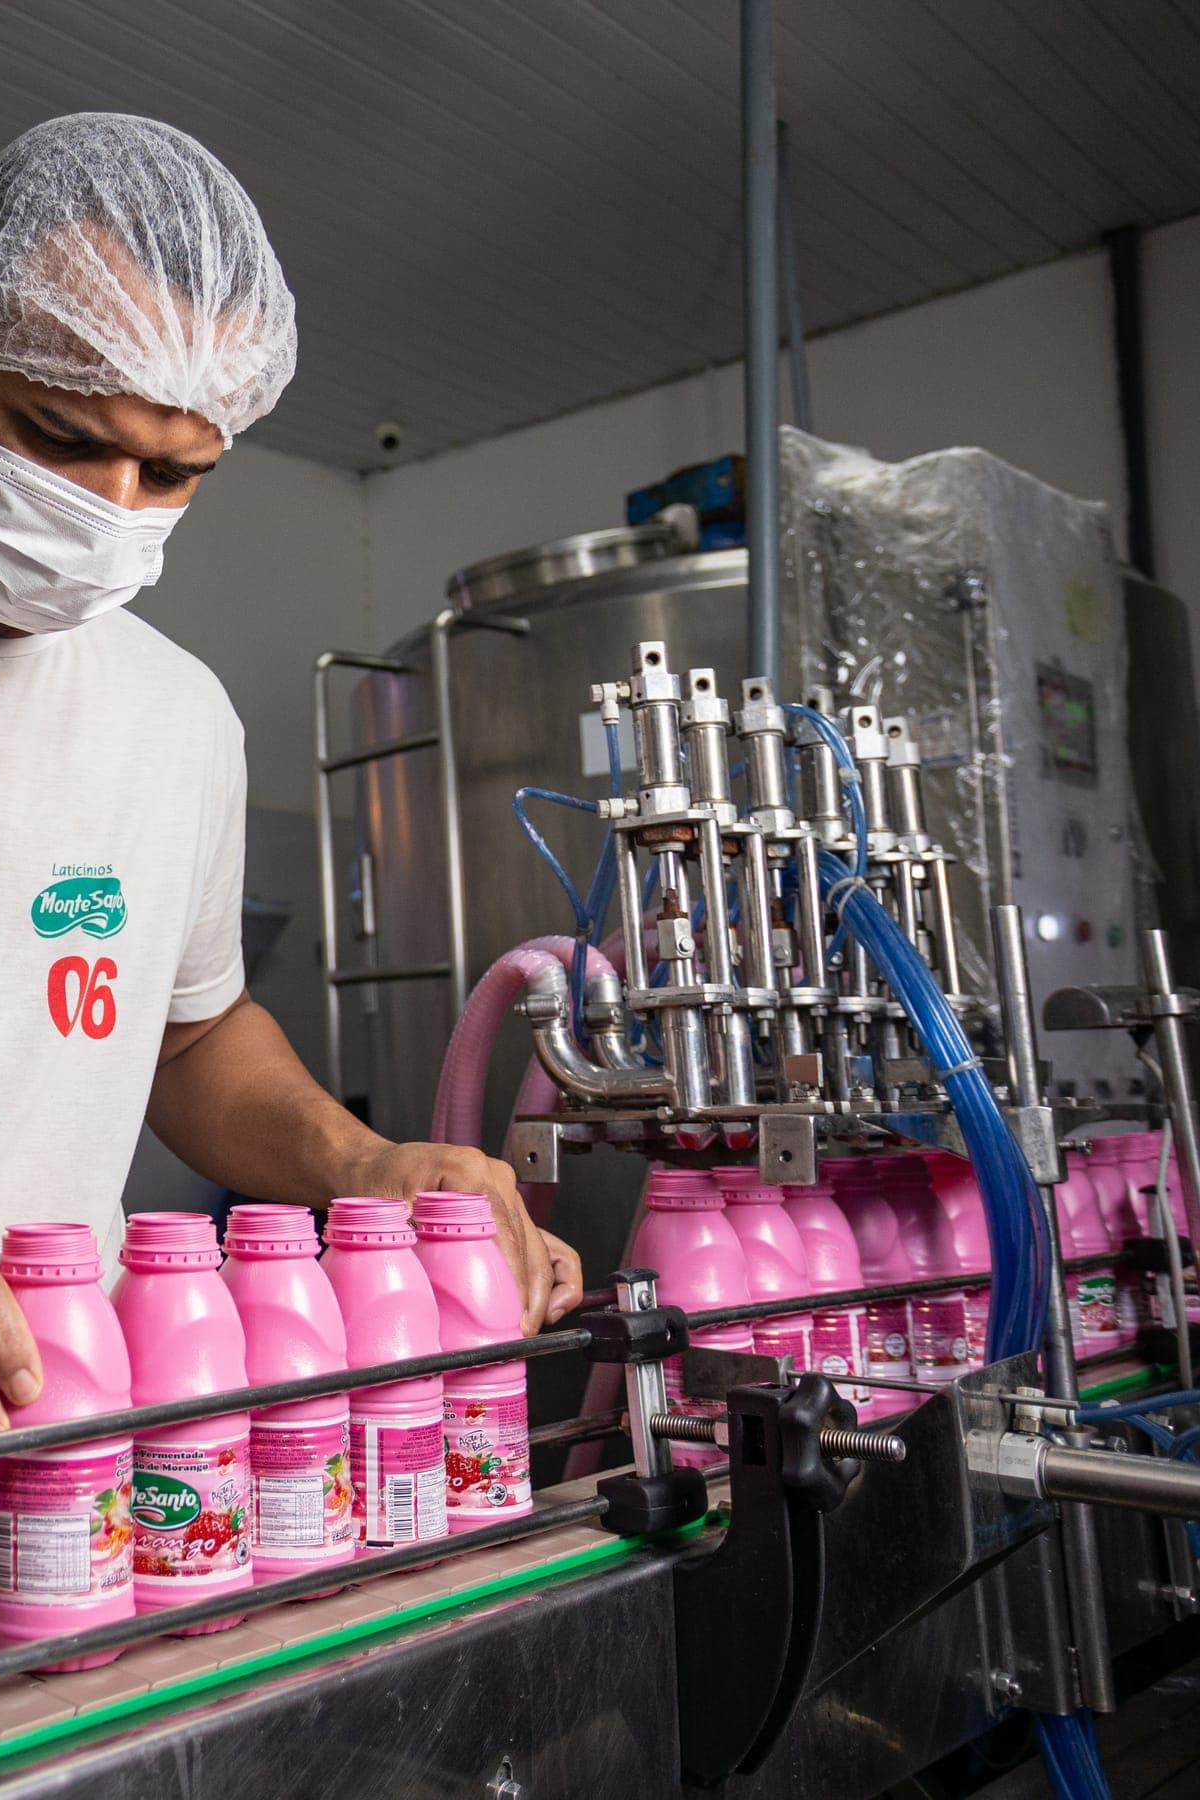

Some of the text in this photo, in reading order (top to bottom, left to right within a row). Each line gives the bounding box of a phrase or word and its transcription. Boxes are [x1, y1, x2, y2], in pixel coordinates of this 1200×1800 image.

[47, 955, 118, 1040] 06
[141, 1450, 204, 1459] Fermentada
[162, 1464, 208, 1472] Morango
[133, 1486, 197, 1511] teSanto
